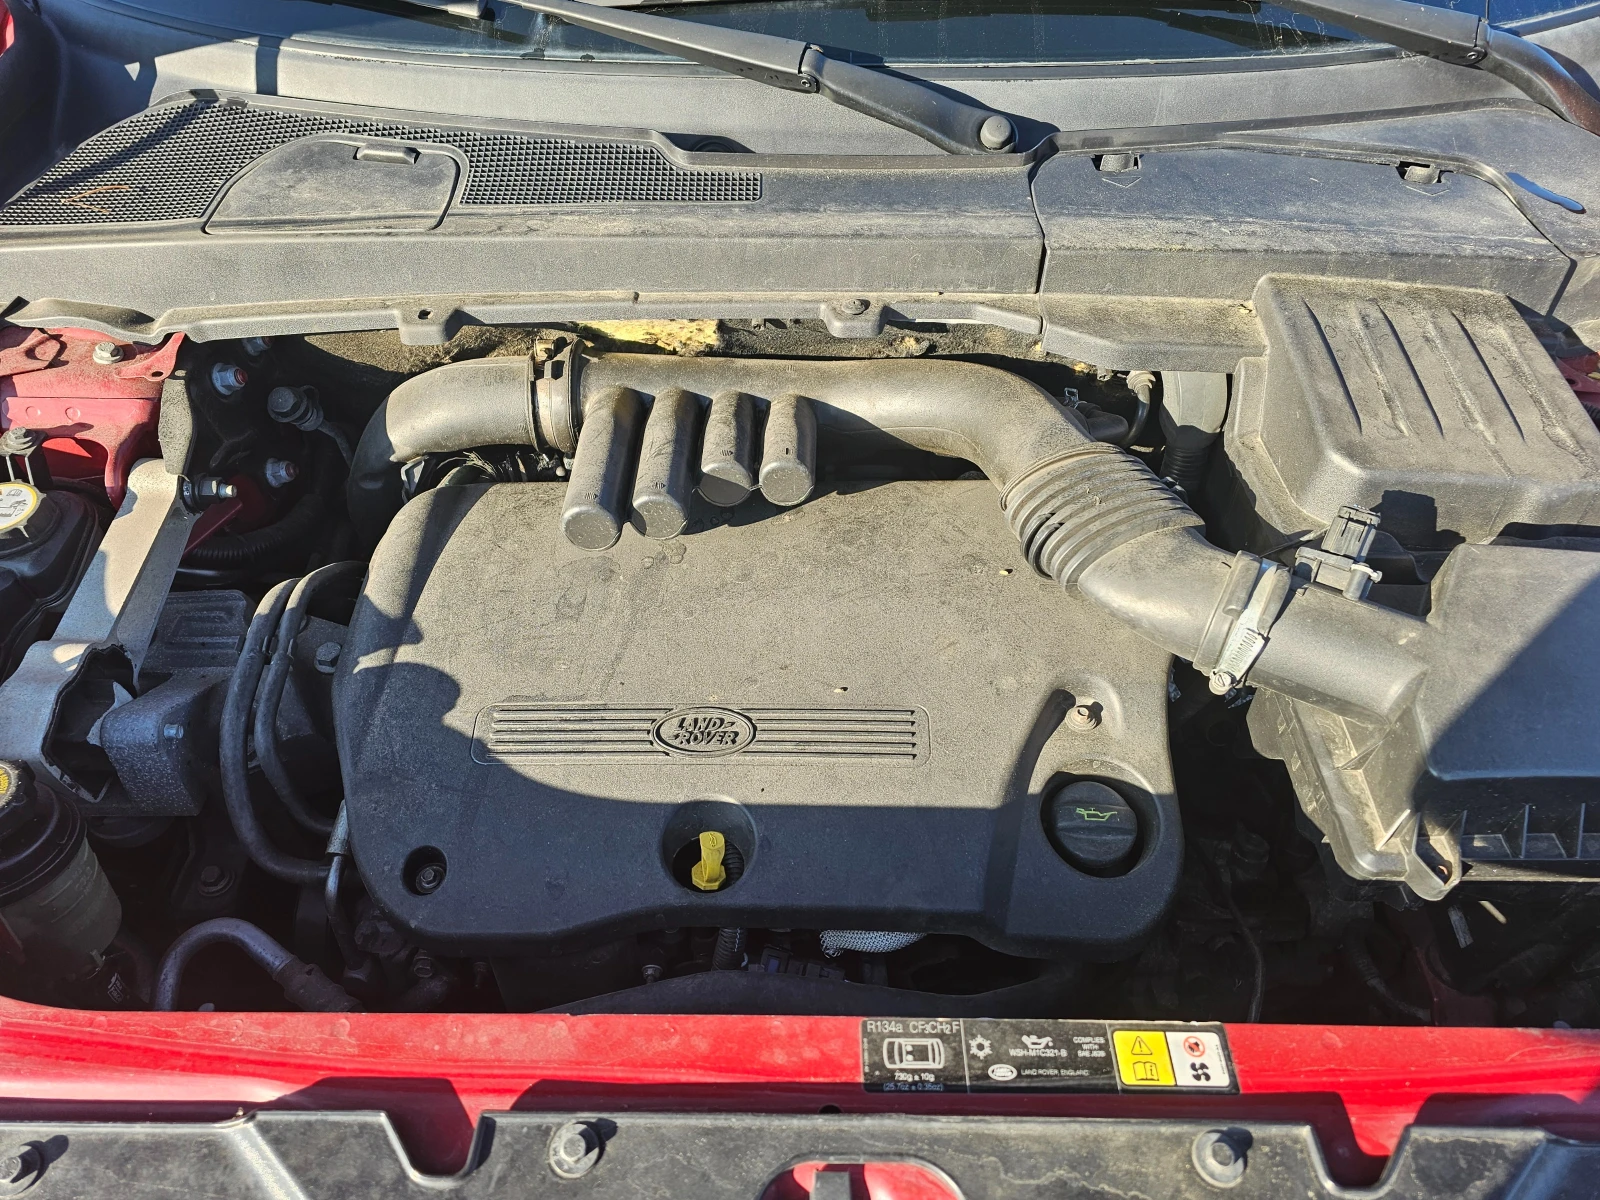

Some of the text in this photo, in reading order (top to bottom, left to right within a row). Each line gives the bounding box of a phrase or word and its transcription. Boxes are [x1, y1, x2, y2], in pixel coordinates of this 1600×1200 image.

[675, 717, 725, 731] LAND
[679, 731, 739, 745] ROVER
[866, 1020, 904, 1033] R134a
[1072, 1036, 1105, 1044] COMPLIES
[1020, 1068, 1037, 1076] LAND
